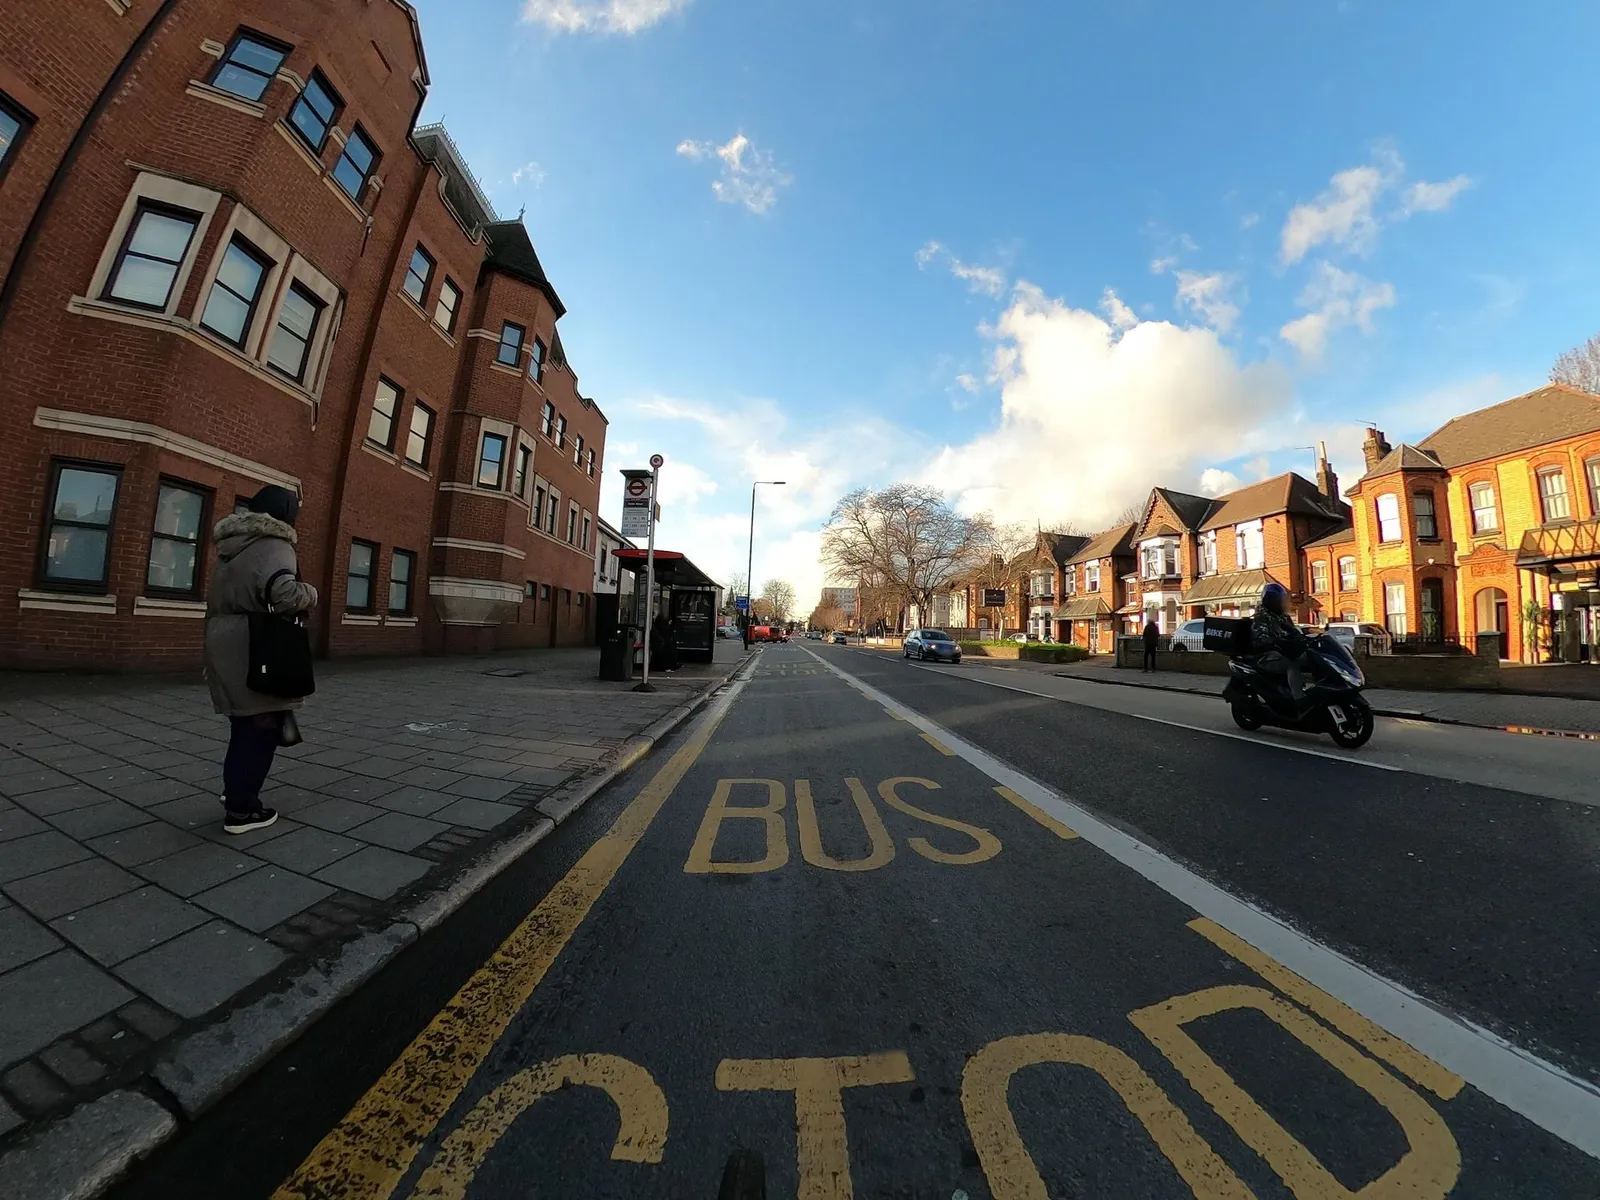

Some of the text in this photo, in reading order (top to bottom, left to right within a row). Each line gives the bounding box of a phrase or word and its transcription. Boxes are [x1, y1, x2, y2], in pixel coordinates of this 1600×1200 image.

[1205, 628, 1223, 638] BIKE
[1333, 708, 1343, 719] L
[682, 777, 1002, 874] BUS
